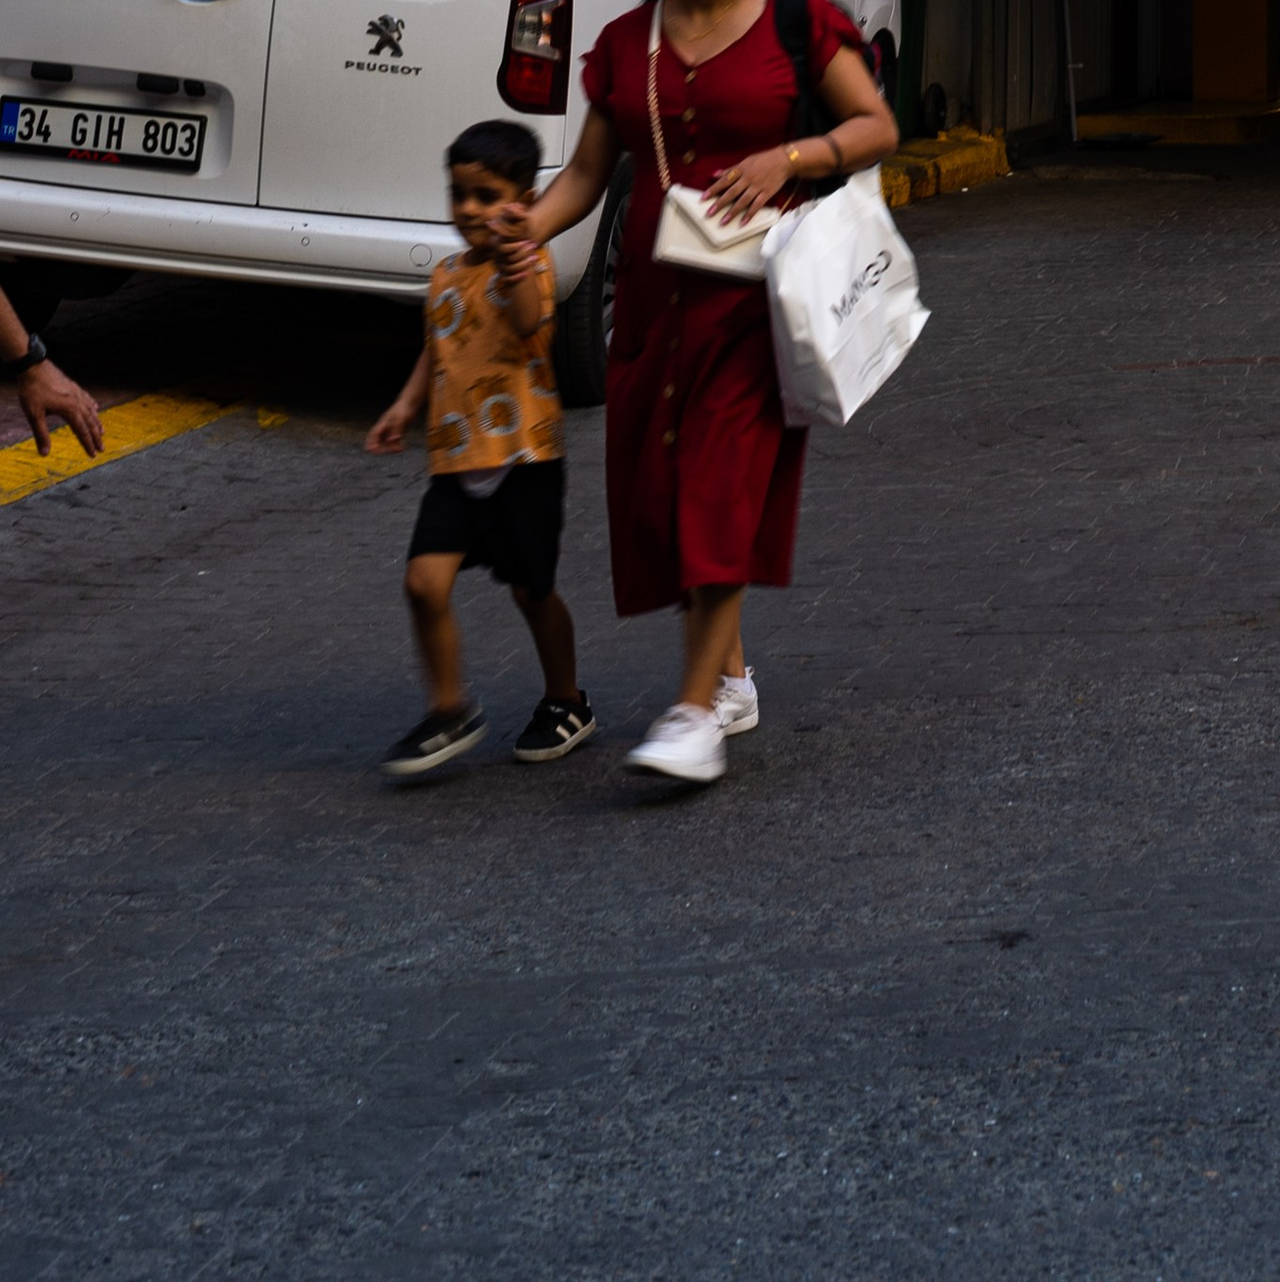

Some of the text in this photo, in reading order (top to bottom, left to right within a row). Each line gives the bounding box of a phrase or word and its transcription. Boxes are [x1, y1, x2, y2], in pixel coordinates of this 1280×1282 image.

[345, 60, 423, 76] PEUGEOT
[3, 108, 197, 157] TR 34 GIH 803
